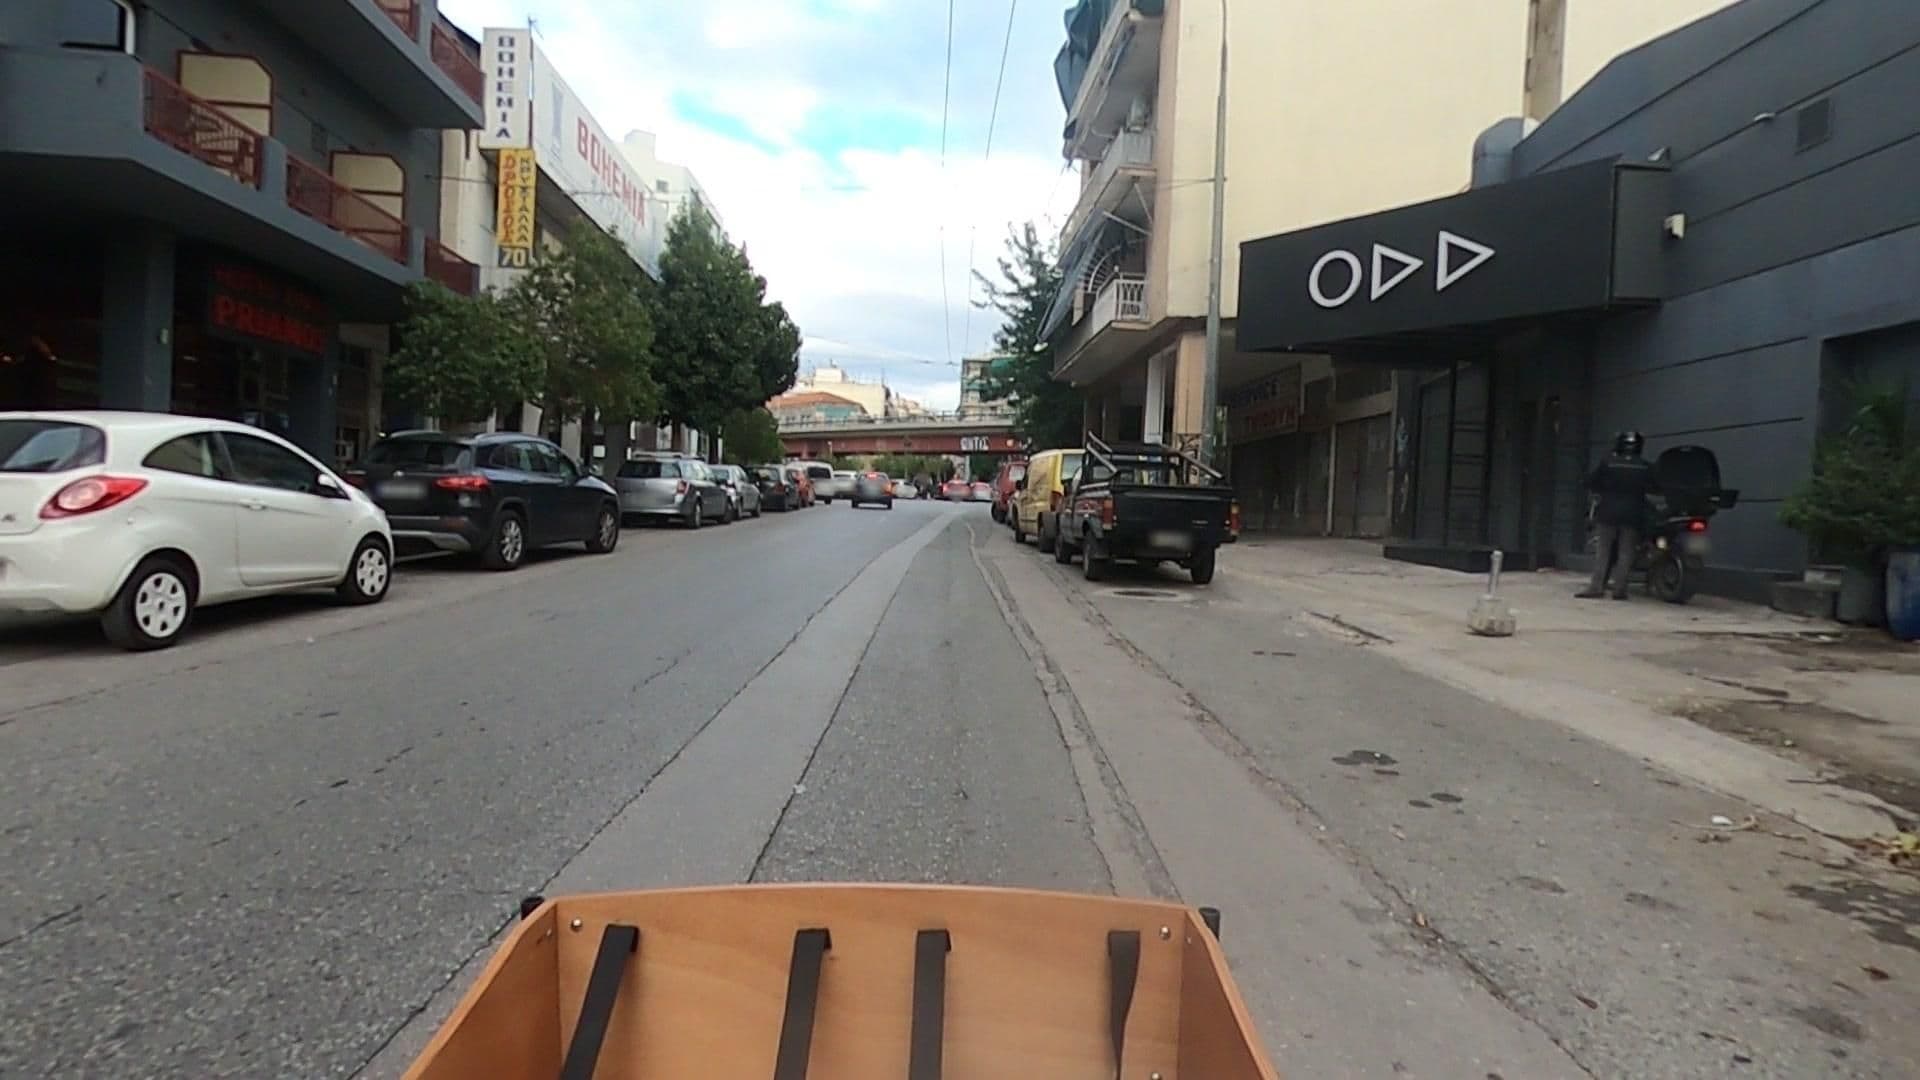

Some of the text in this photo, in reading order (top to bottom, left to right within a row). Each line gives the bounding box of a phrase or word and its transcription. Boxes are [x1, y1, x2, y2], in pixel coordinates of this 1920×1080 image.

[496, 36, 514, 138] BOHEMIA
[578, 117, 645, 226] BOHEMIA
[501, 248, 526, 267] 70
